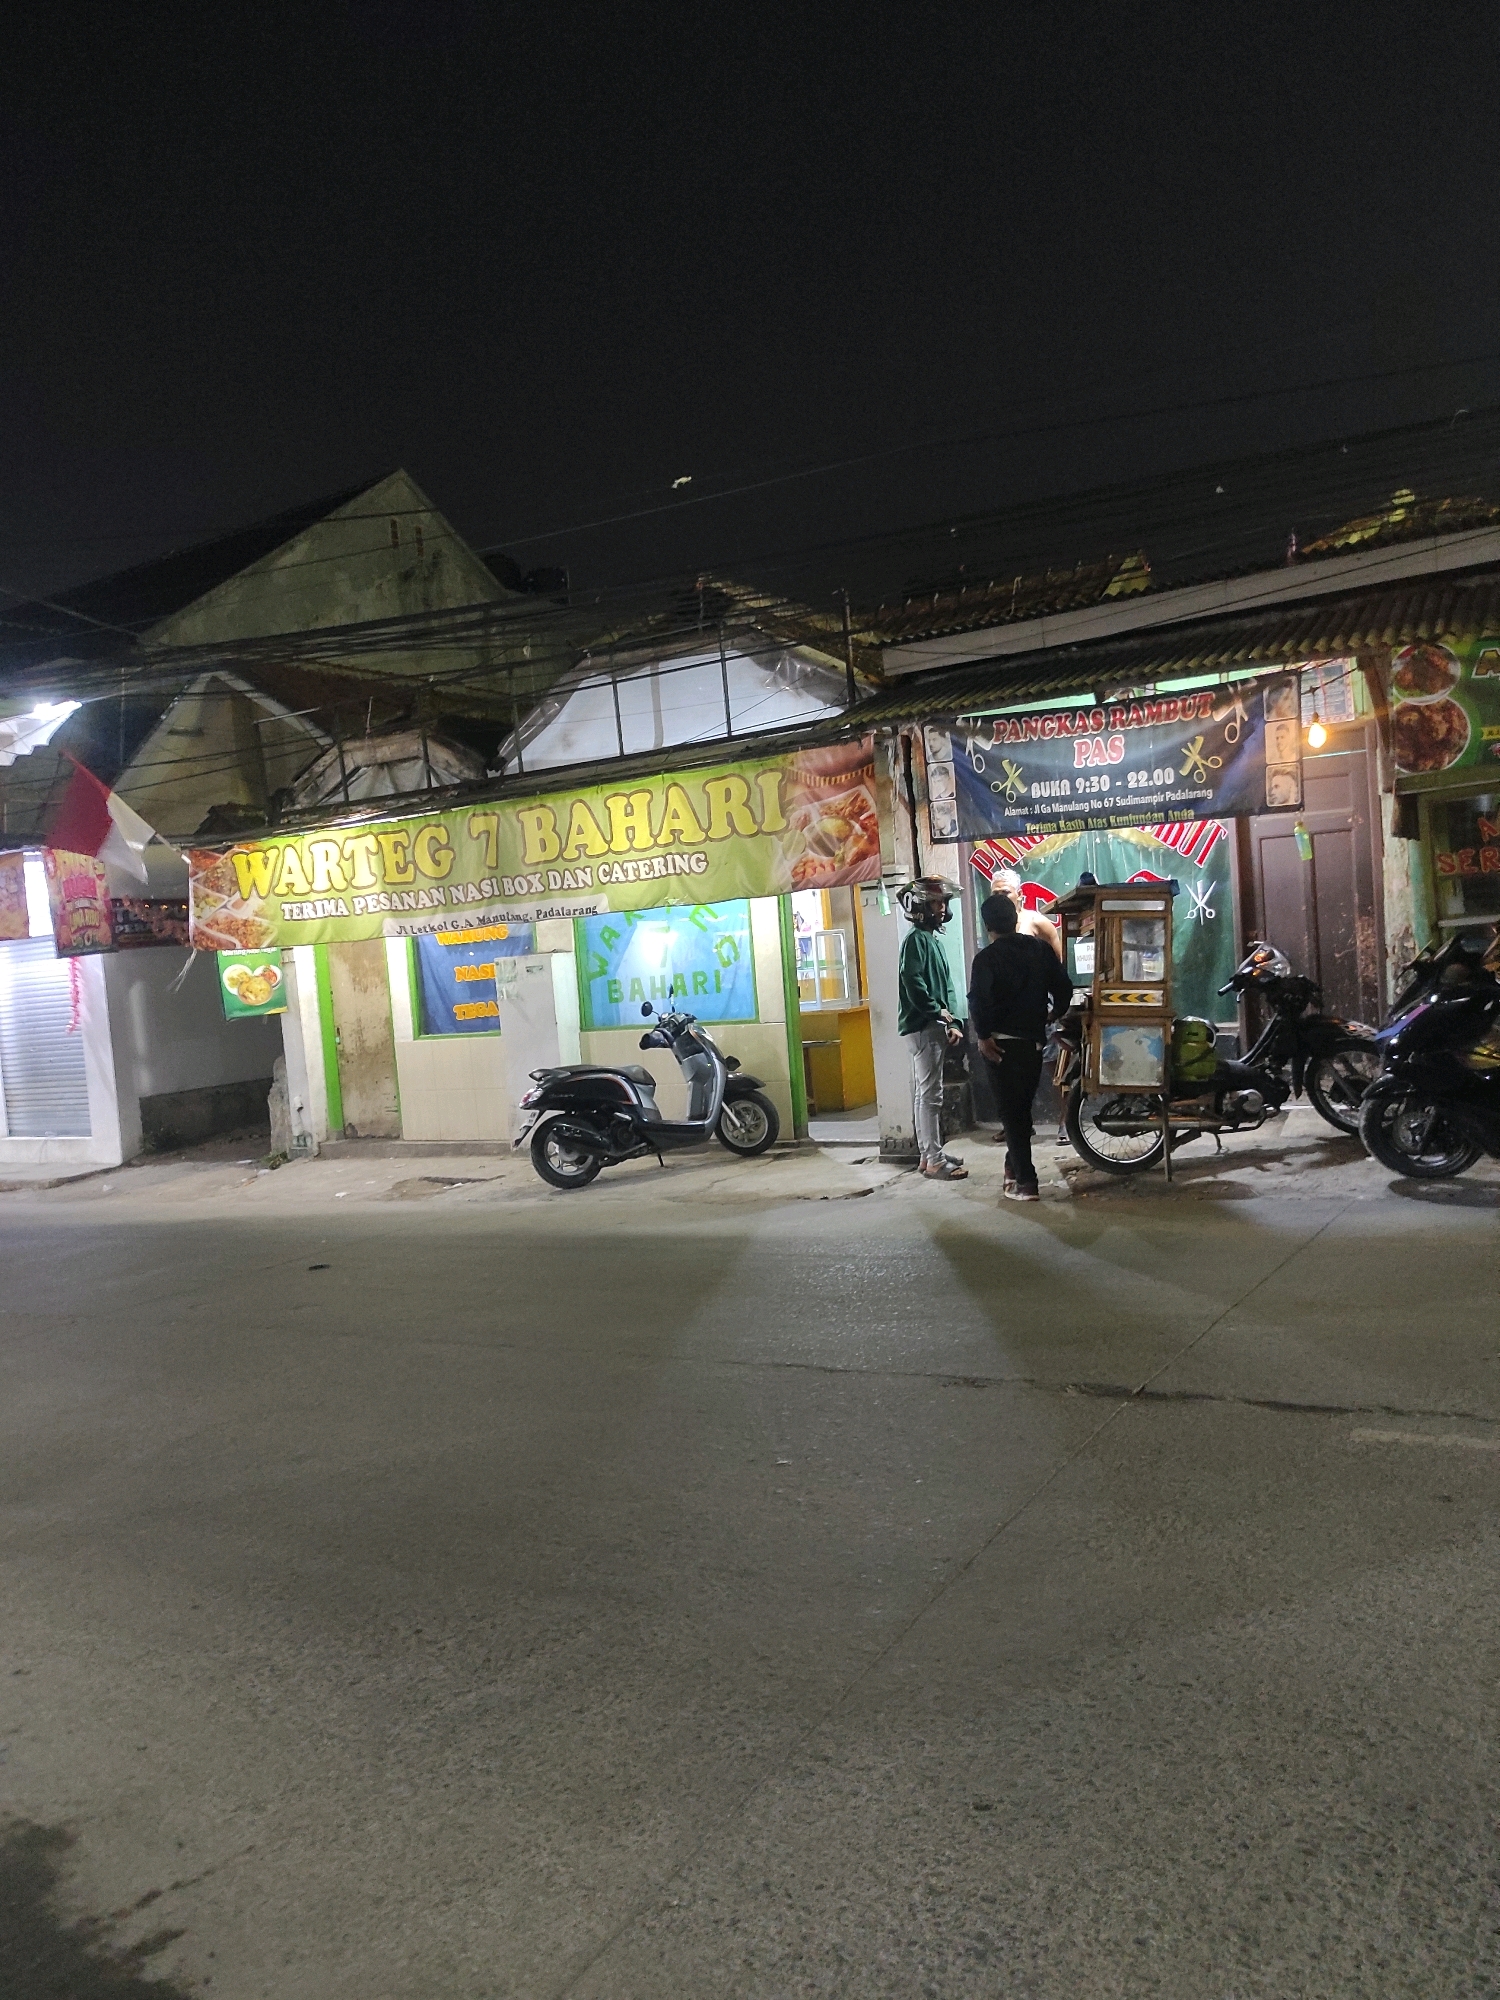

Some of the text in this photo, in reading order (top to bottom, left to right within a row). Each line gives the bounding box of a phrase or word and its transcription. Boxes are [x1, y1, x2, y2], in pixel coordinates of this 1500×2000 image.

[993, 691, 1214, 744] PANGKAS RAMBUT
[1073, 735, 1124, 768] PAS
[1031, 779, 1070, 798] BUKA
[1075, 775, 1110, 794] 9:30
[1127, 767, 1175, 788] 22.00
[1004, 807, 1029, 816] Alamat
[1041, 804, 1051, 813] Ga
[1052, 801, 1089, 812] Manulang
[1090, 799, 1102, 809] No
[1103, 798, 1114, 808] 67
[1115, 793, 1164, 807] Sudimampir
[1166, 788, 1213, 801] Padalarang
[231, 768, 789, 900] WARTEG 7 BAHARI
[1025, 808, 1195, 834] Terima Kasih Atas Kunjungan Anda
[281, 851, 709, 921] TERIMA PESANAN NASI BOX DAN CATERING
[410, 921, 448, 934] Letkol
[451, 918, 474, 930] G.A
[535, 905, 599, 920] Padalarang
[454, 963, 496, 982] NASI
[606, 969, 722, 1004] BAHARI
